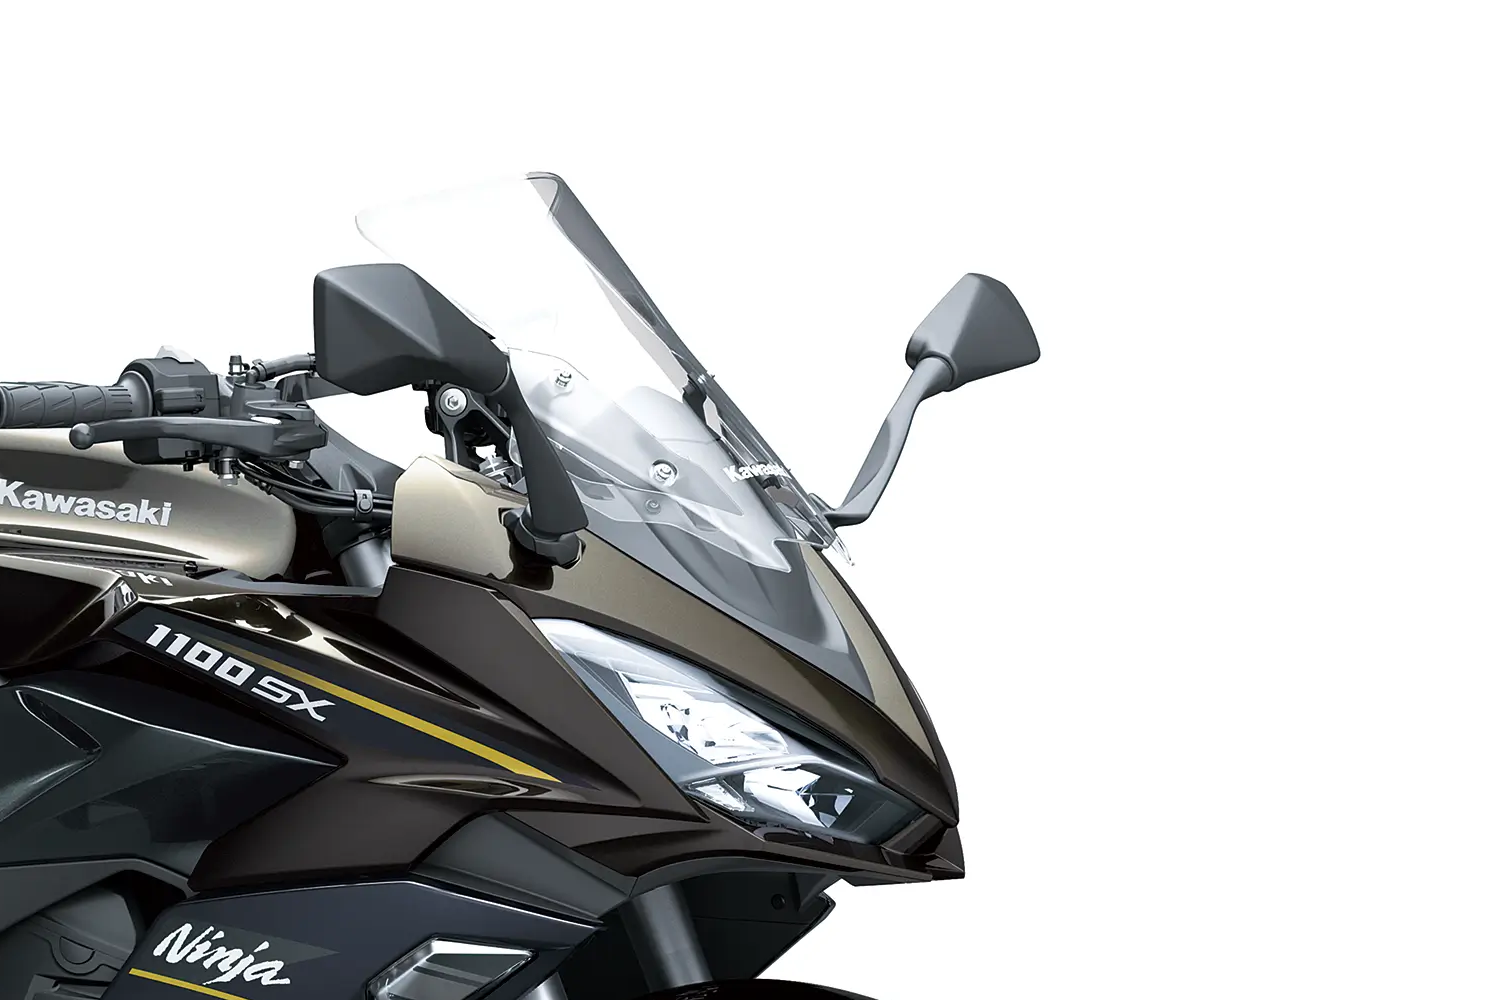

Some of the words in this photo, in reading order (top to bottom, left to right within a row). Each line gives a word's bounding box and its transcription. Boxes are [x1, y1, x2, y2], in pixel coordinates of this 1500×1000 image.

[145, 623, 256, 687] 1100
[251, 675, 336, 722] SX
[153, 922, 291, 986] Ninja
